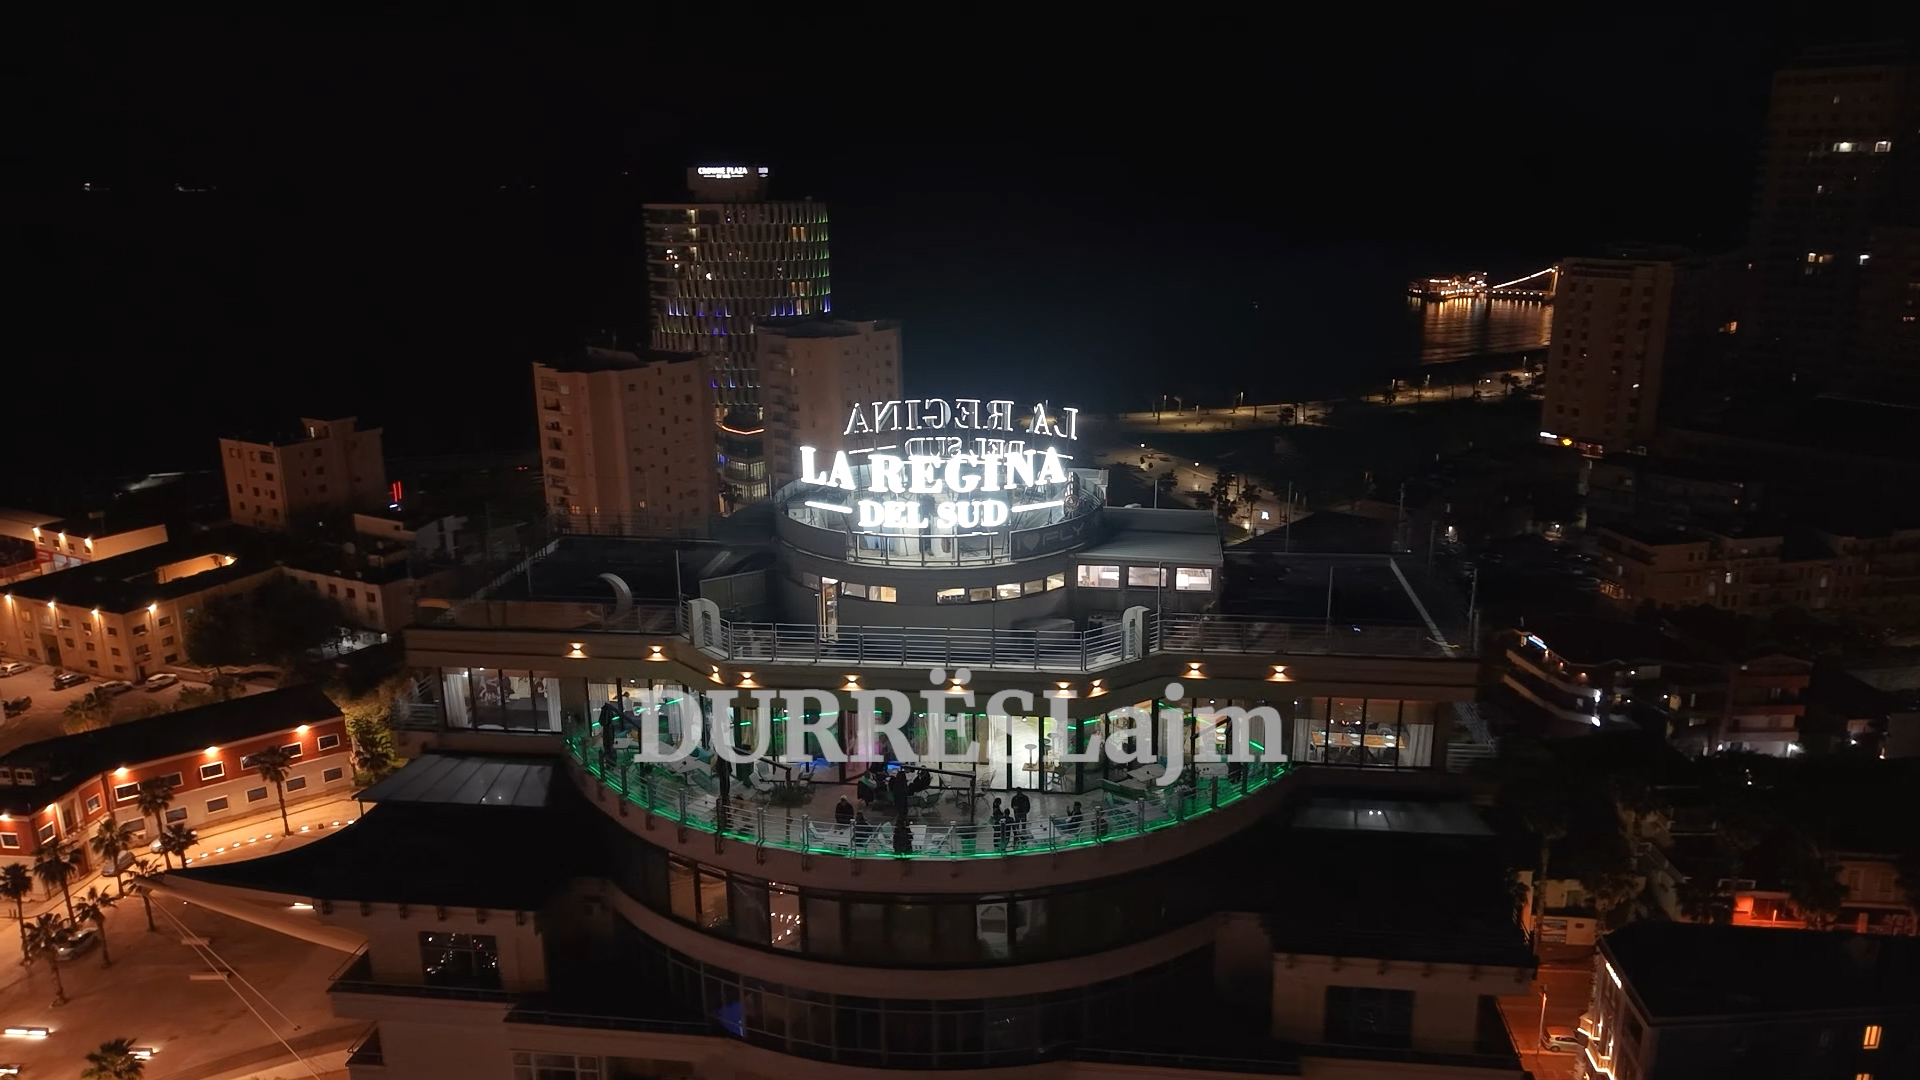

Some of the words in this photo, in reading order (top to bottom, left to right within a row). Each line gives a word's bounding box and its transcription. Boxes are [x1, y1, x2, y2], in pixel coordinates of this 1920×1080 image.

[726, 167, 748, 175] PLAZA
[799, 446, 856, 490] LA
[867, 446, 1069, 493] REGINA
[858, 500, 929, 529] DEL
[937, 499, 1008, 529] SUD
[1042, 522, 1085, 547] FLY
